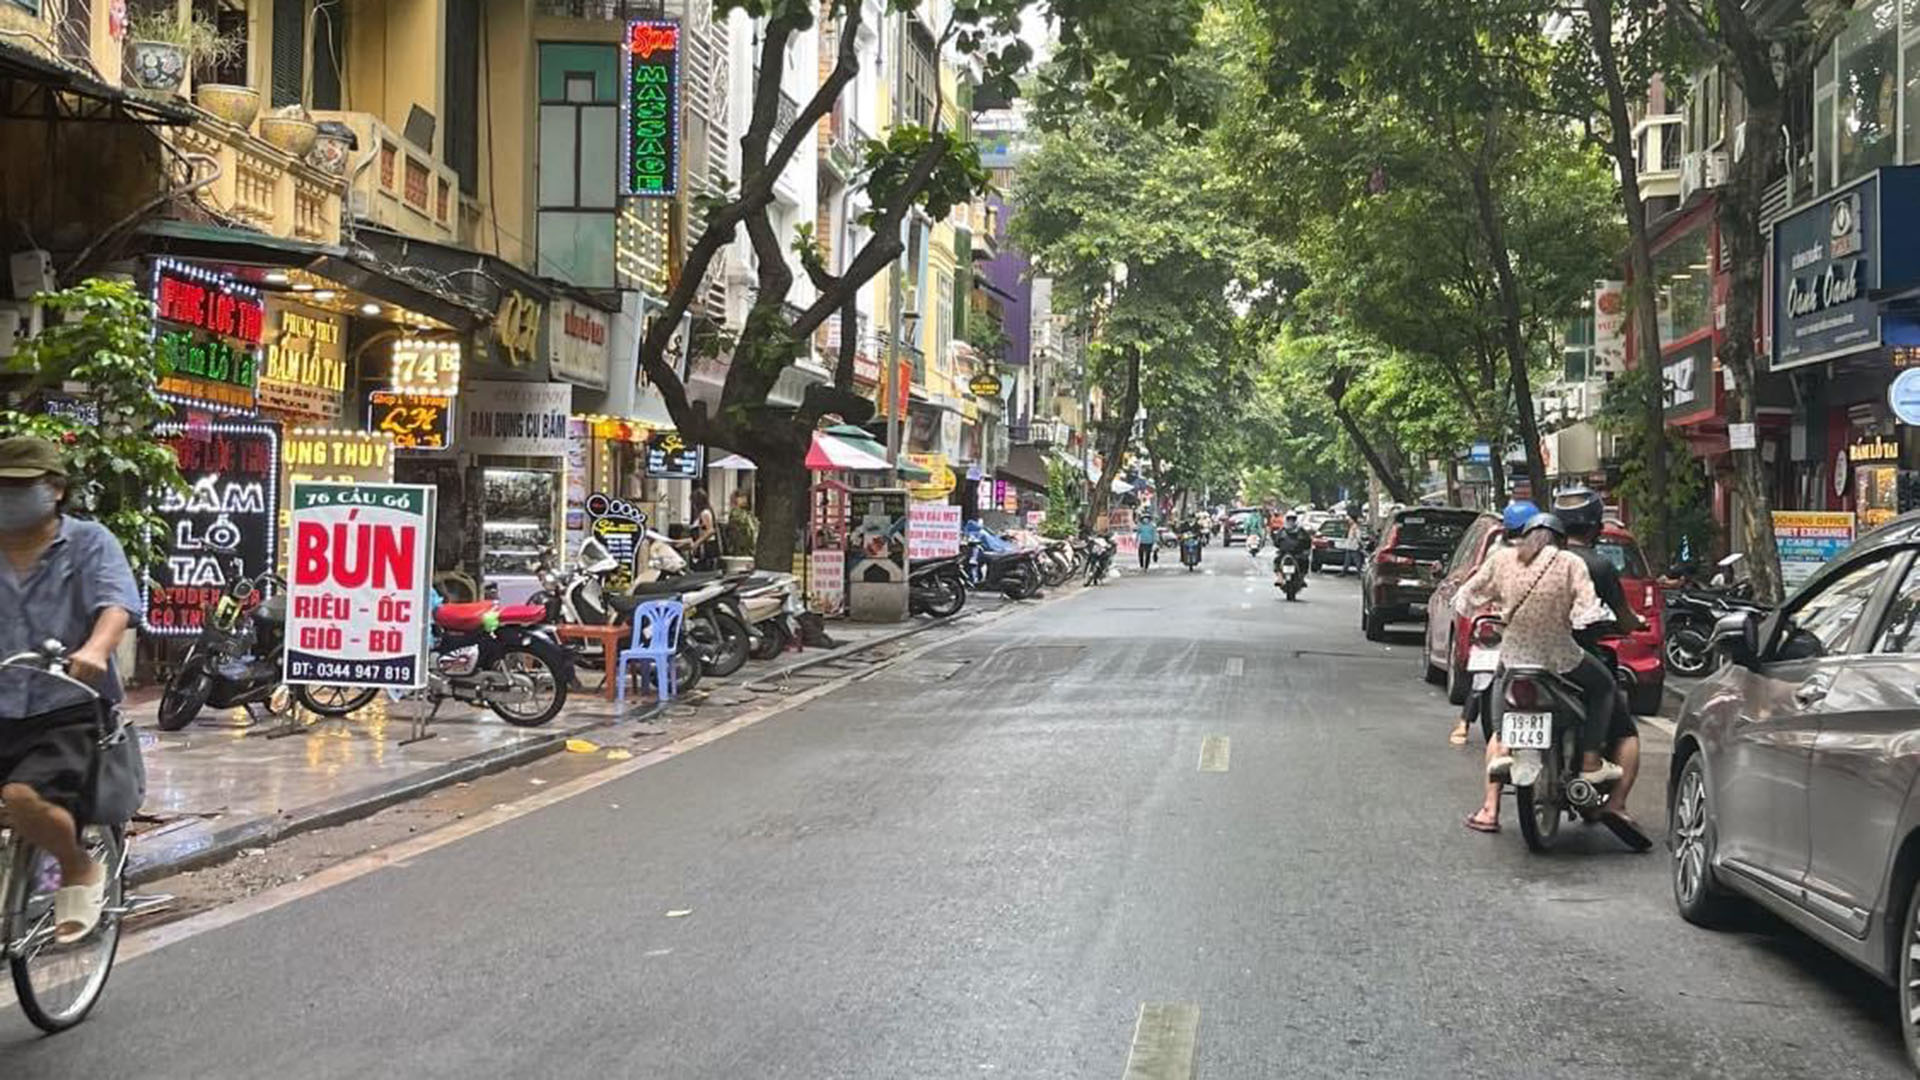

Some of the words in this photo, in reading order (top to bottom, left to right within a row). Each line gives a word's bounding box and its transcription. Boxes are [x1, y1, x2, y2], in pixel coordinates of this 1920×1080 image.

[632, 25, 675, 59] Spa
[636, 66, 668, 190] MASSAGE
[322, 358, 347, 392] TAI
[306, 492, 331, 506] 76
[295, 508, 416, 590] BÚN
[294, 592, 350, 621] RIÊU
[300, 622, 342, 651] GIÒ
[369, 625, 403, 653] BÒ
[317, 663, 350, 679] 0344
[355, 665, 380, 680] 947
[384, 667, 411, 682] 819
[1511, 716, 1544, 729] 19-R1
[1510, 731, 1544, 746] 0449
